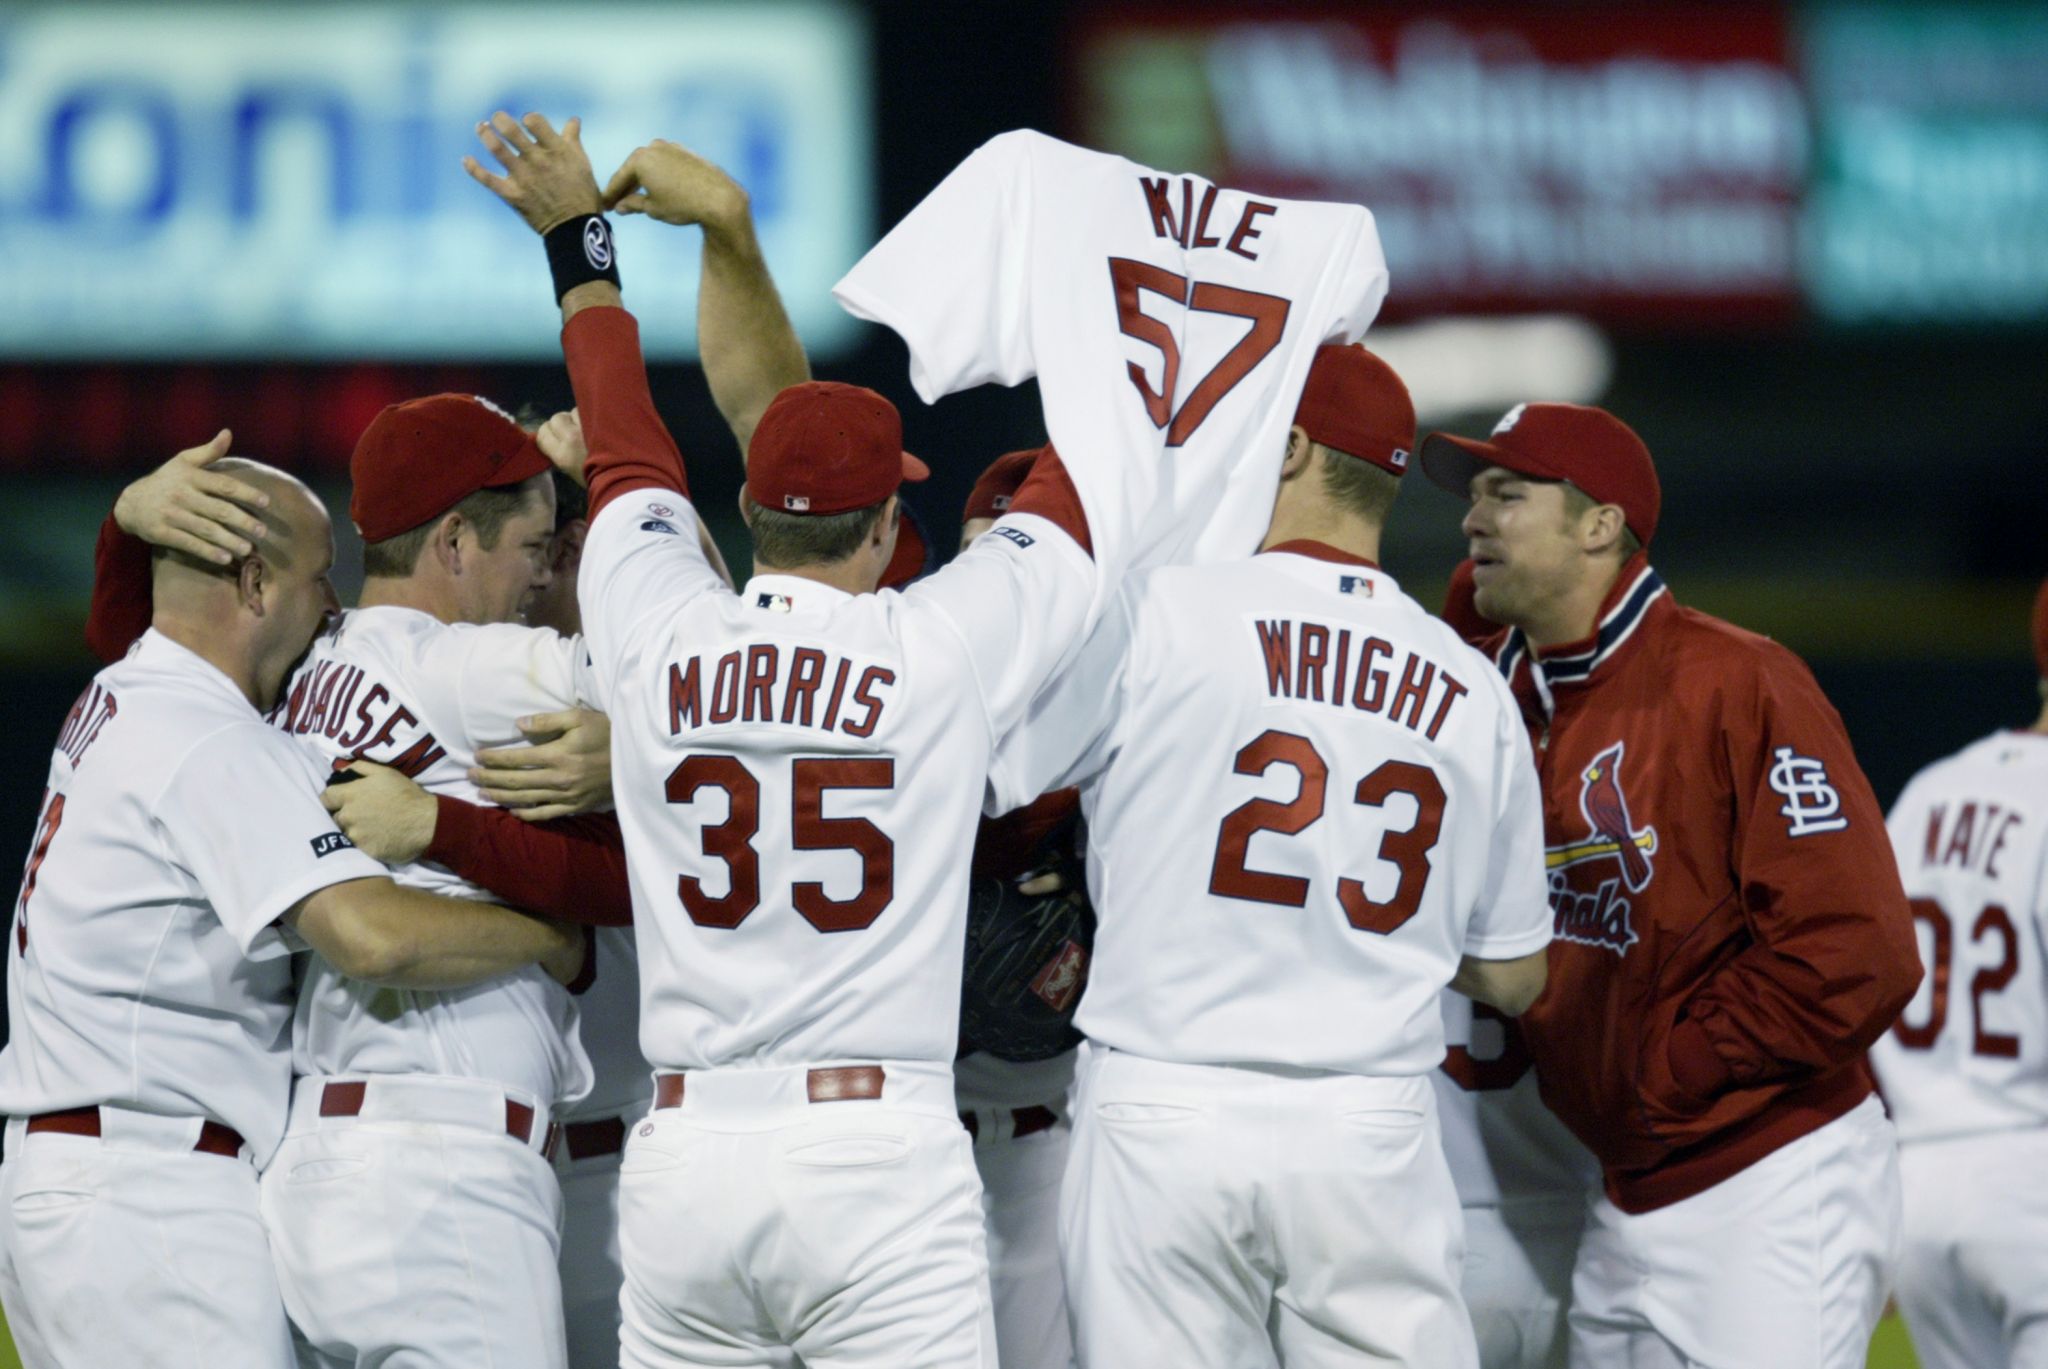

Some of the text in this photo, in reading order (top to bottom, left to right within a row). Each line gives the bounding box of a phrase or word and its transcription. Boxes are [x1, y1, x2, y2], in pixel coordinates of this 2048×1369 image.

[1139, 177, 1278, 261] KILE
[1108, 256, 1292, 447] 57
[668, 644, 895, 739] MORRIS
[1256, 620, 1468, 742] WRIGHT
[664, 754, 895, 933] 35
[1208, 729, 1448, 936] 23
[1922, 802, 2023, 879] NATE
